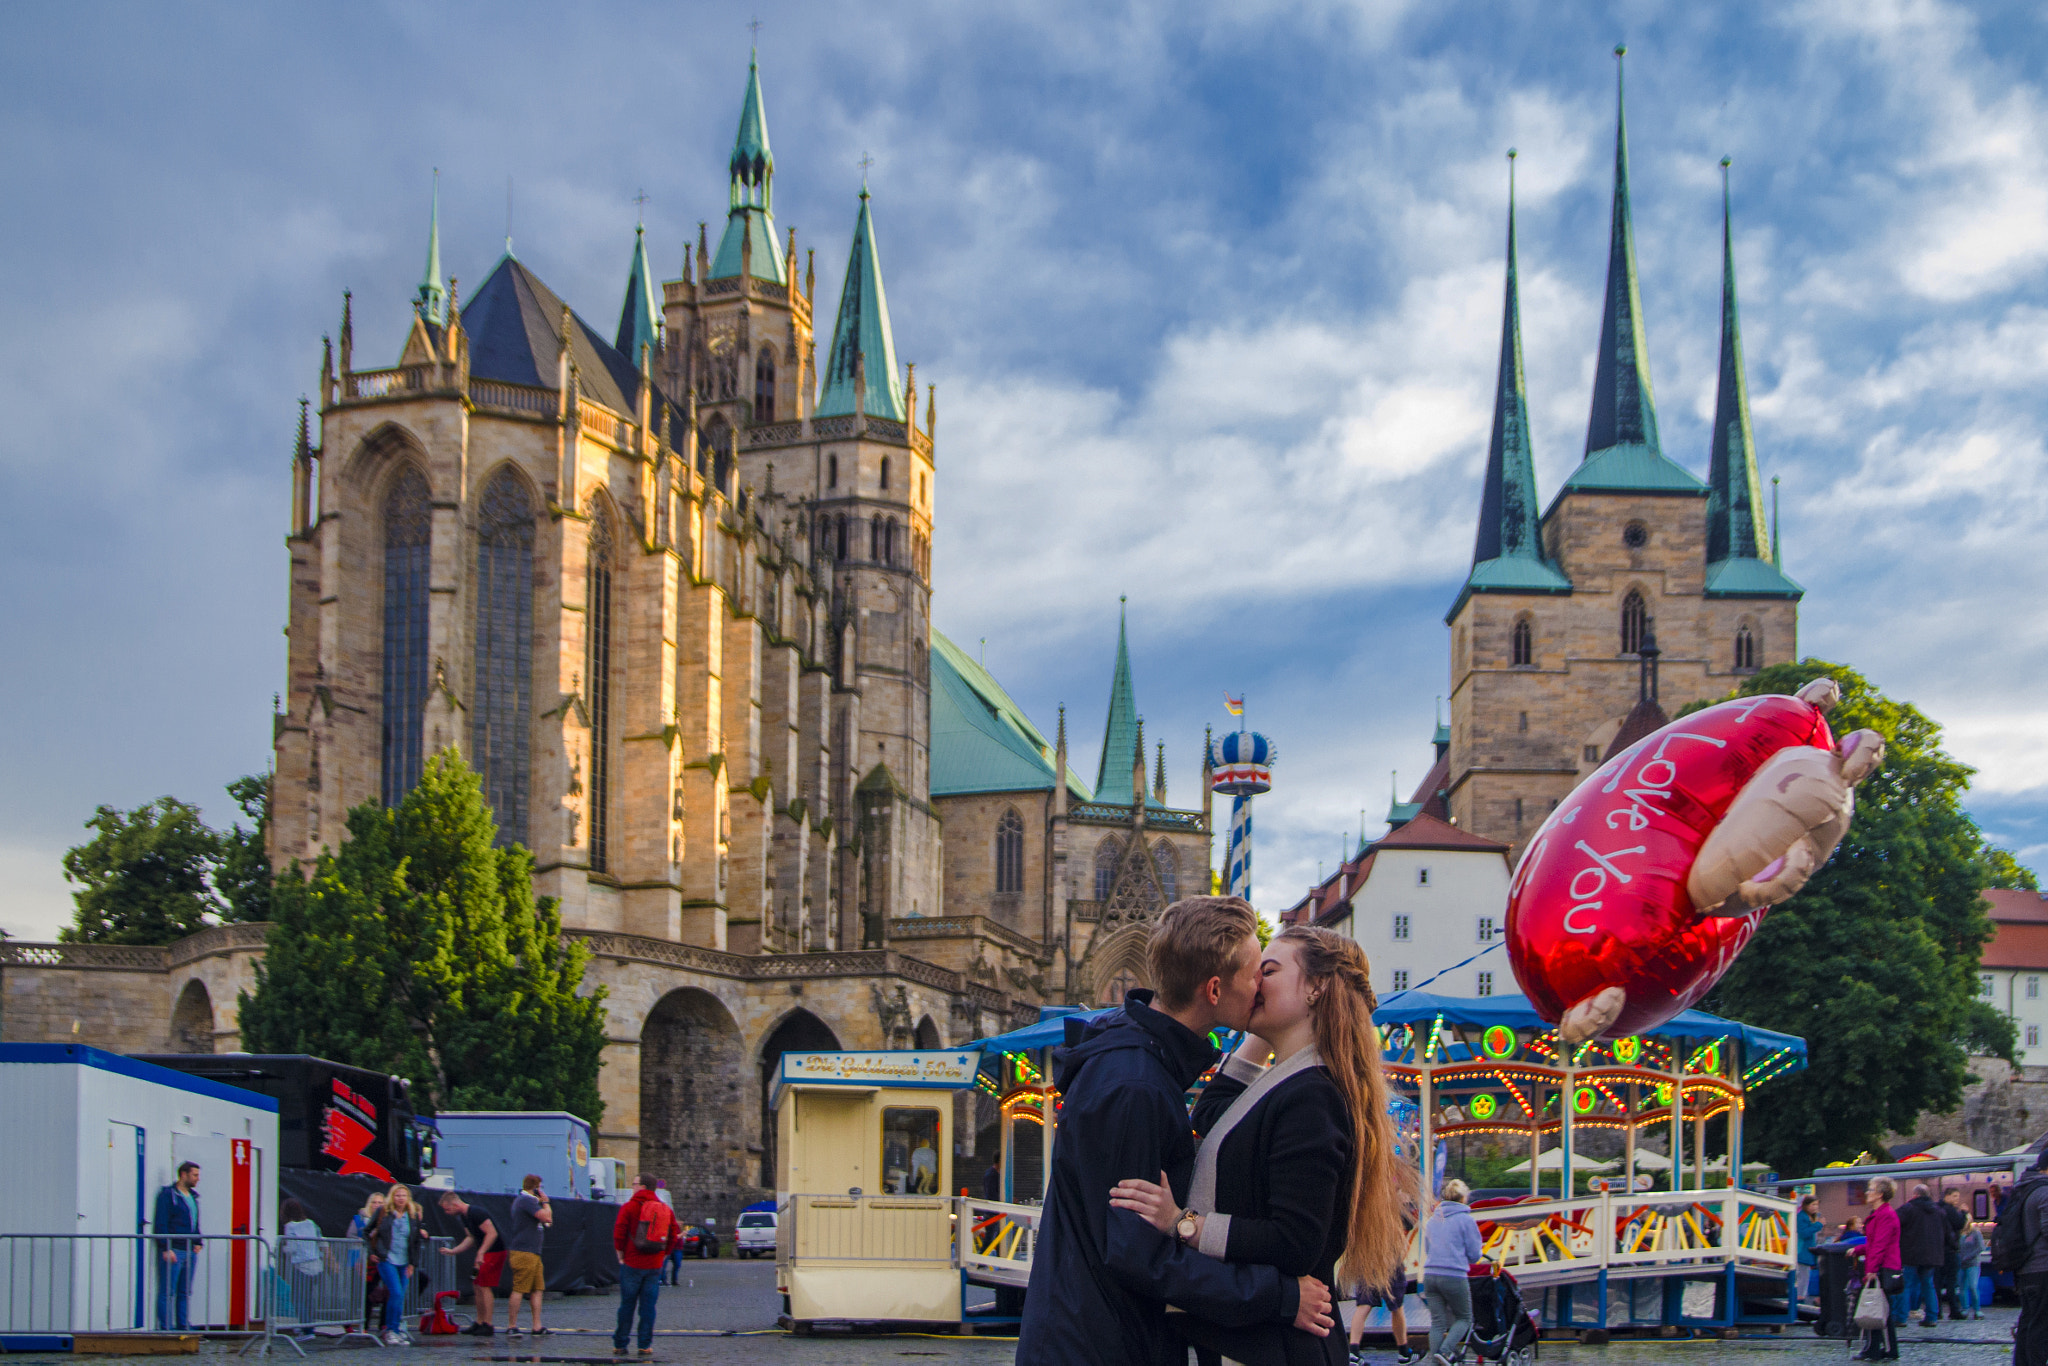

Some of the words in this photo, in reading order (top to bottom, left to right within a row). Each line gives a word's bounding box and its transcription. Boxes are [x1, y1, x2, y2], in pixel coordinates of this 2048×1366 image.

[1606, 732, 1727, 831] Love
[1563, 839, 1647, 934] You
[805, 1055, 836, 1072] Die
[840, 1056, 919, 1078] Goldenen
[922, 1059, 963, 1078] 50er
